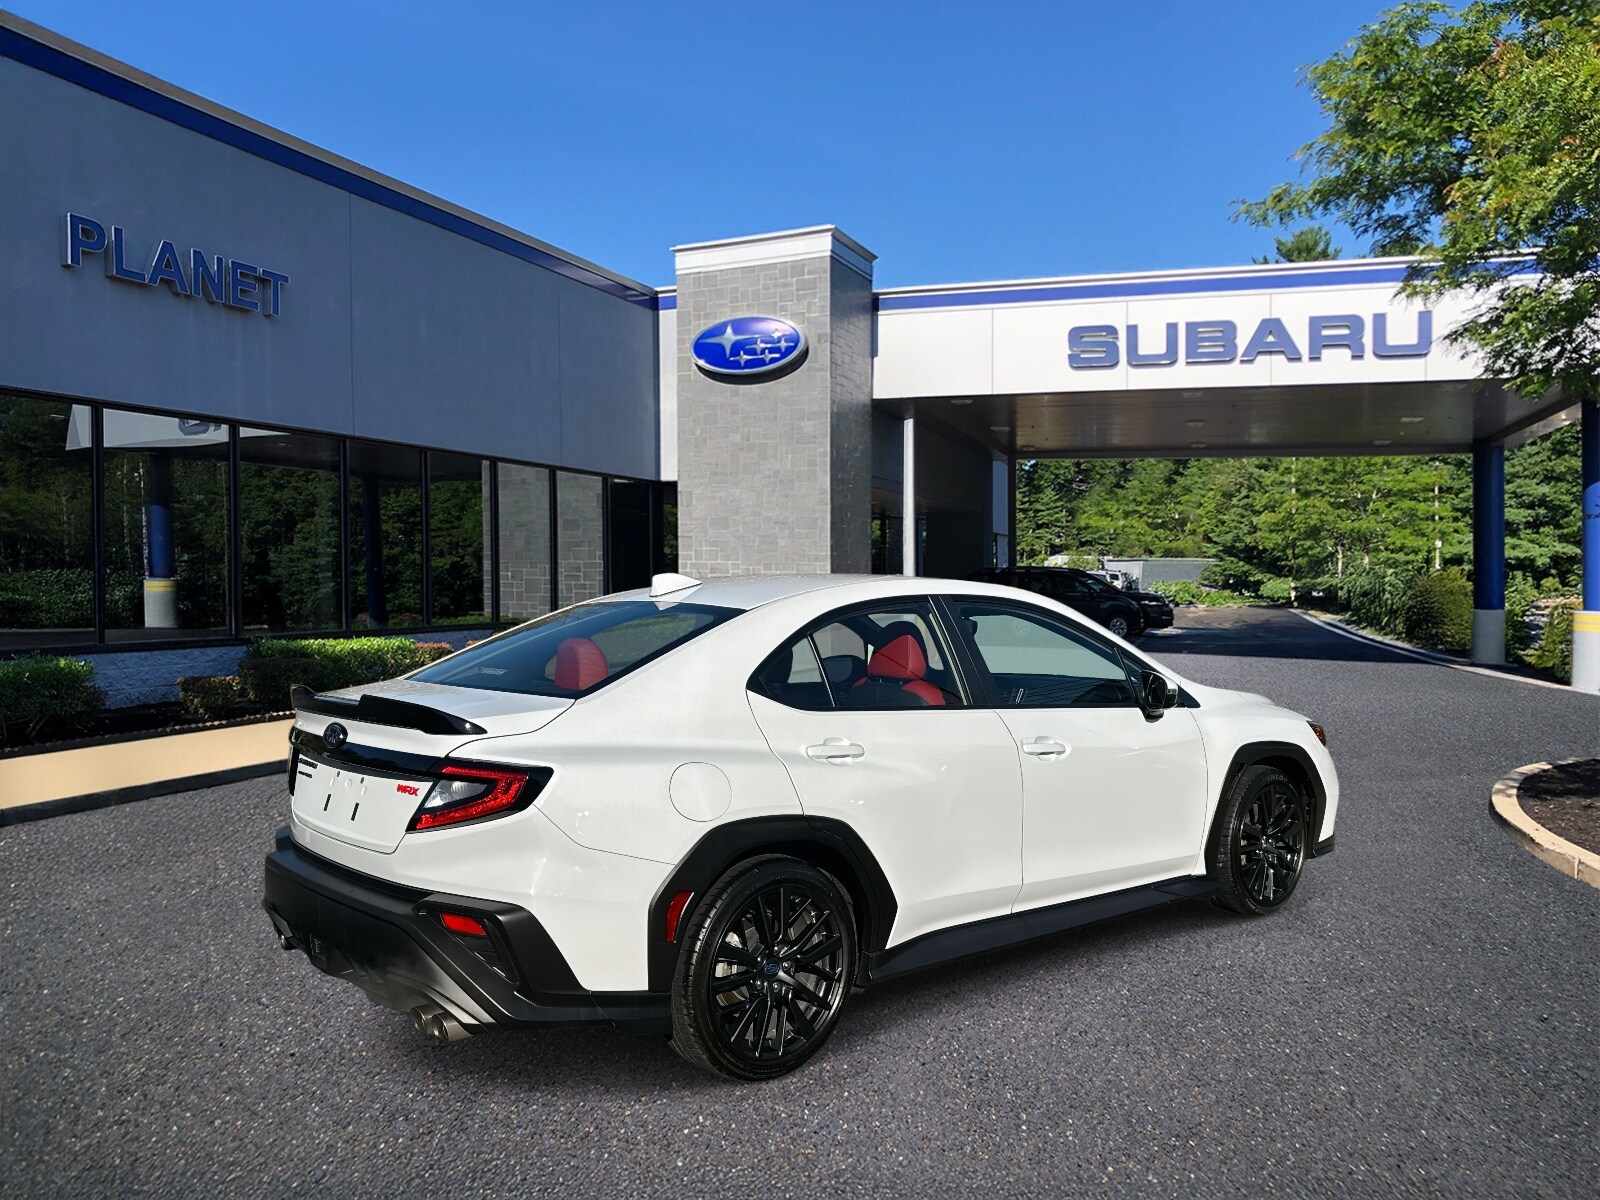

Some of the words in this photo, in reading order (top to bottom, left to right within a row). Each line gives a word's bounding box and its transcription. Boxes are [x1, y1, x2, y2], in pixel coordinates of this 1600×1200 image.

[63, 212, 290, 317] PLANET
[1067, 310, 1433, 369] SUBARU
[396, 783, 420, 797] WRX
